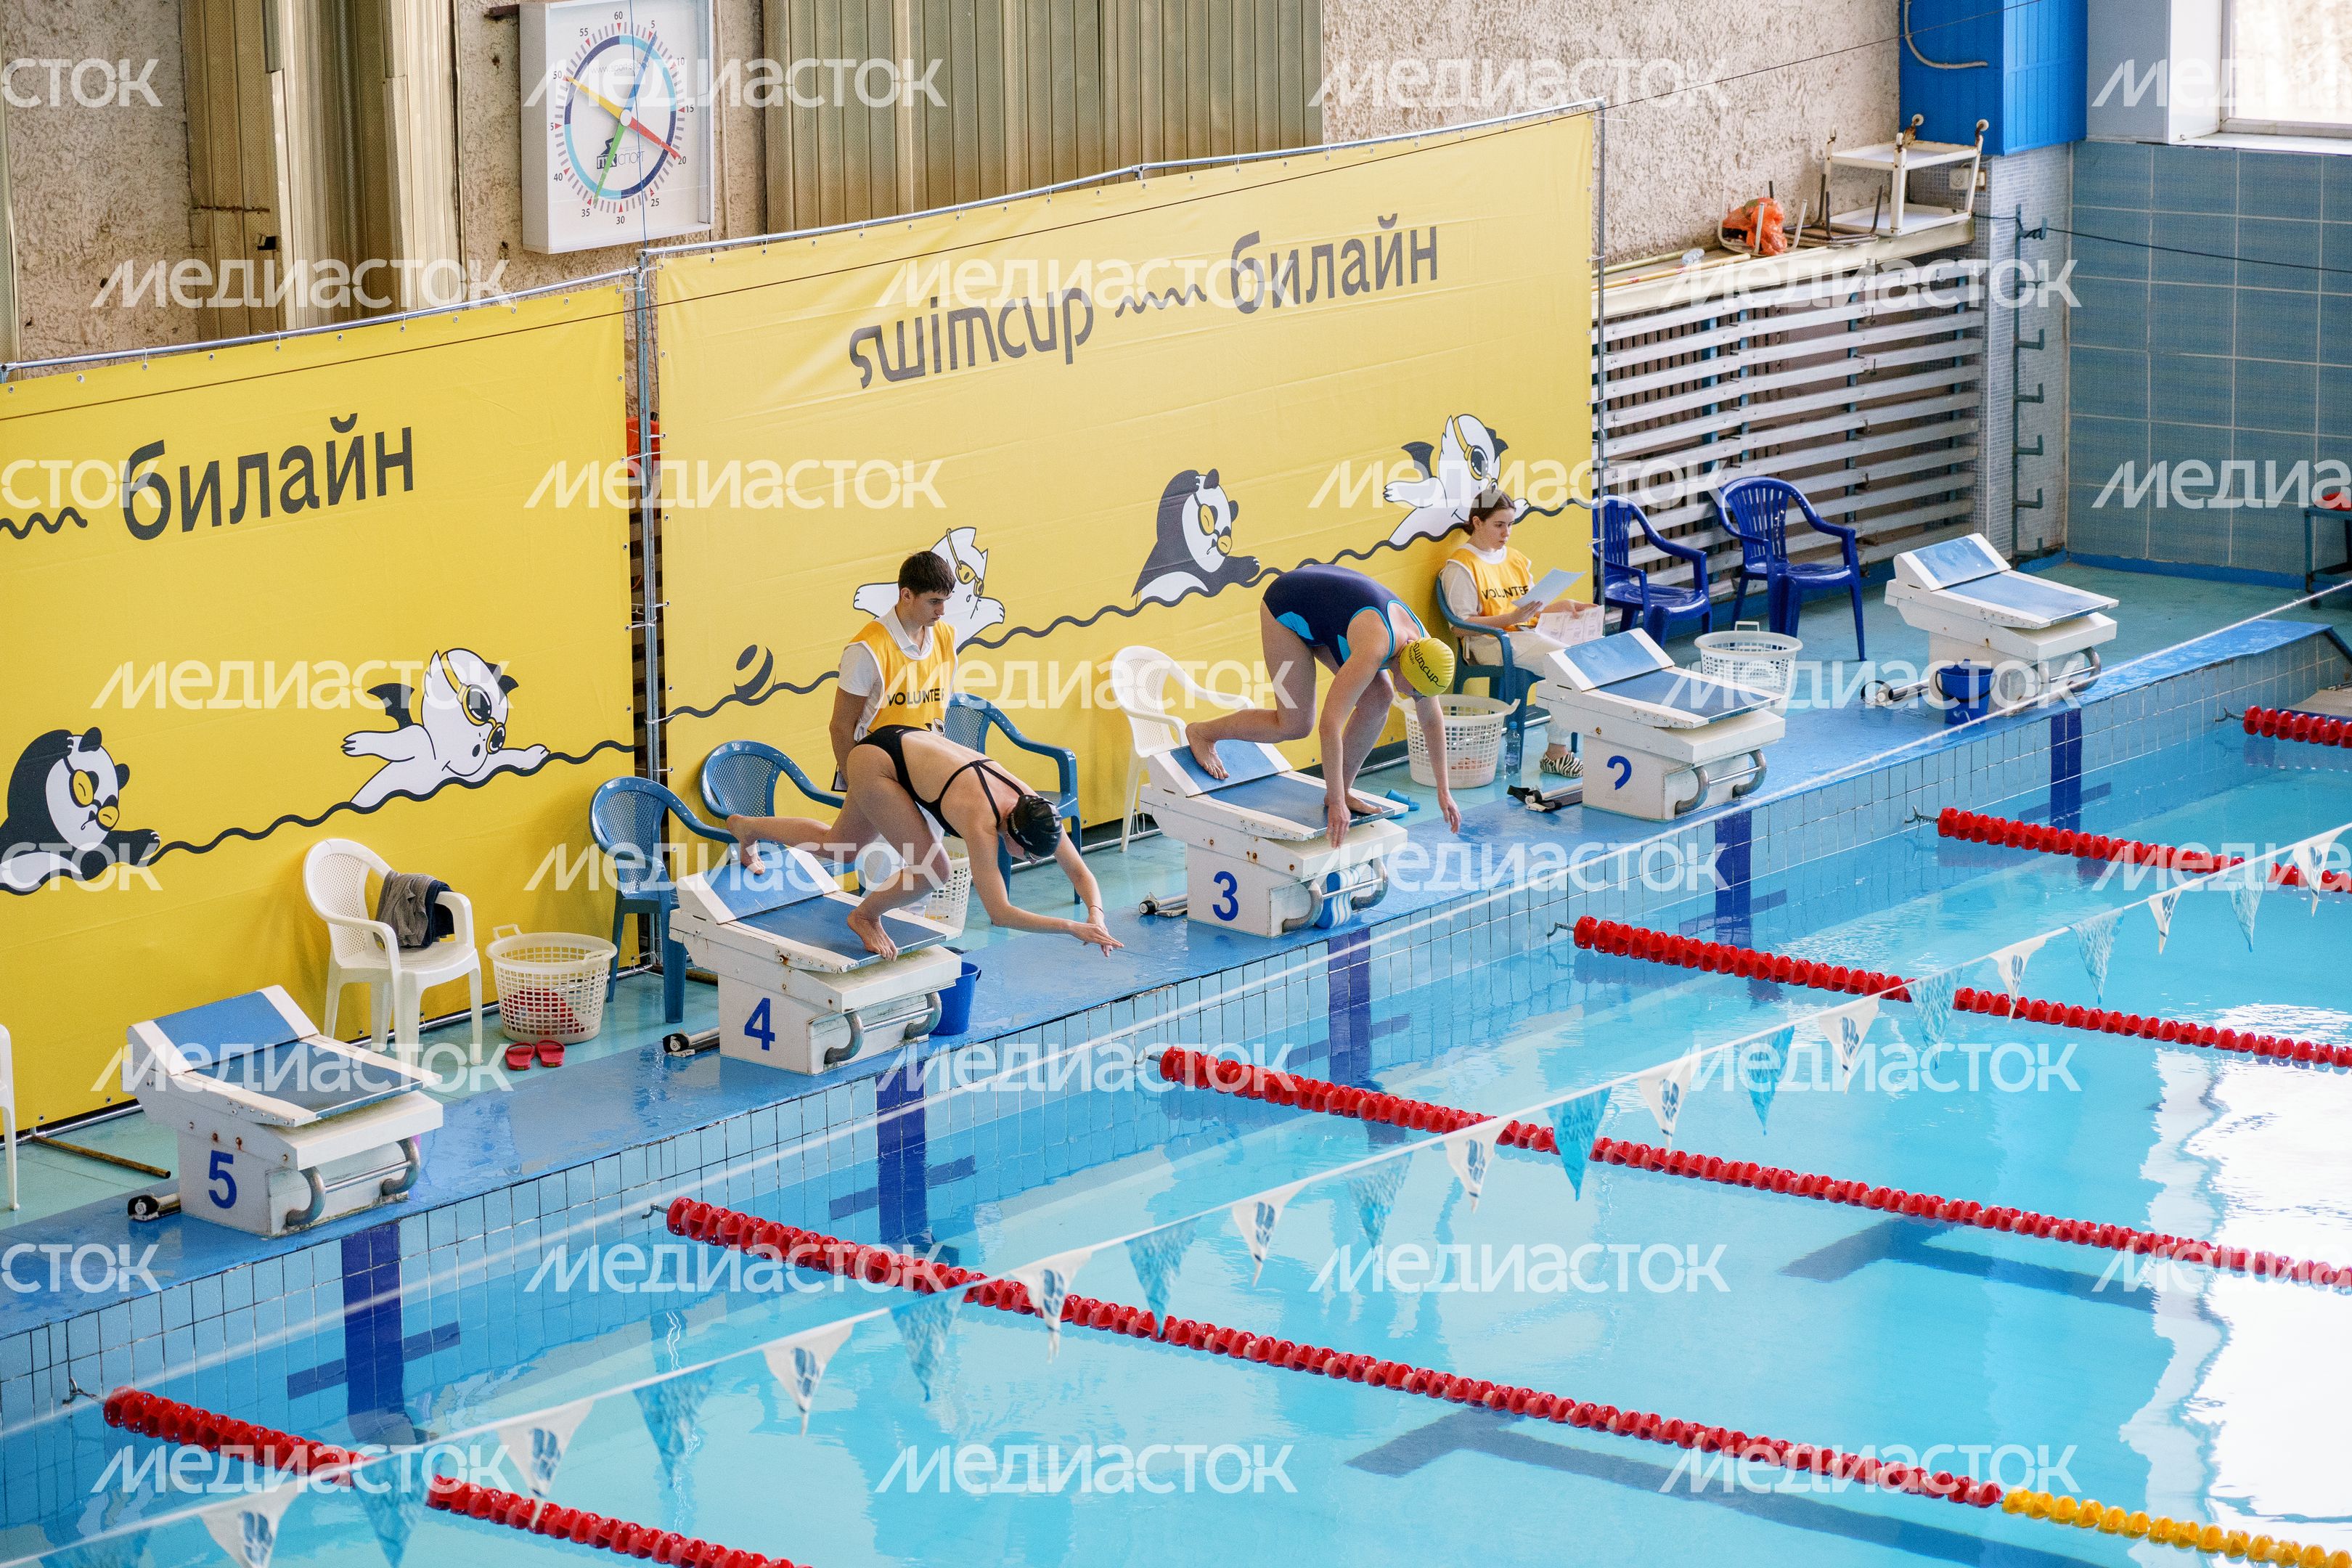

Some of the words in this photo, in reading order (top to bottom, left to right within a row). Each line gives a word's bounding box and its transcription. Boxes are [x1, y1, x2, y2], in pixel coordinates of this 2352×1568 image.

[614, 11, 623, 20] 60
[650, 20, 655, 28] 5
[579, 28, 589, 36] 55
[553, 70, 562, 79] 50
[686, 105, 694, 113] 15
[678, 156, 687, 165] 20
[553, 173, 563, 181] 40
[650, 198, 660, 207] 25
[581, 208, 590, 217] 35
[616, 216, 625, 224] 30
[1230, 213, 1437, 314] билайн
[849, 287, 1094, 388] swimcup
[123, 412, 414, 541] билайн
[1212, 870, 1239, 921] 3
[743, 997, 775, 1051] 4
[208, 1149, 237, 1209] 5
